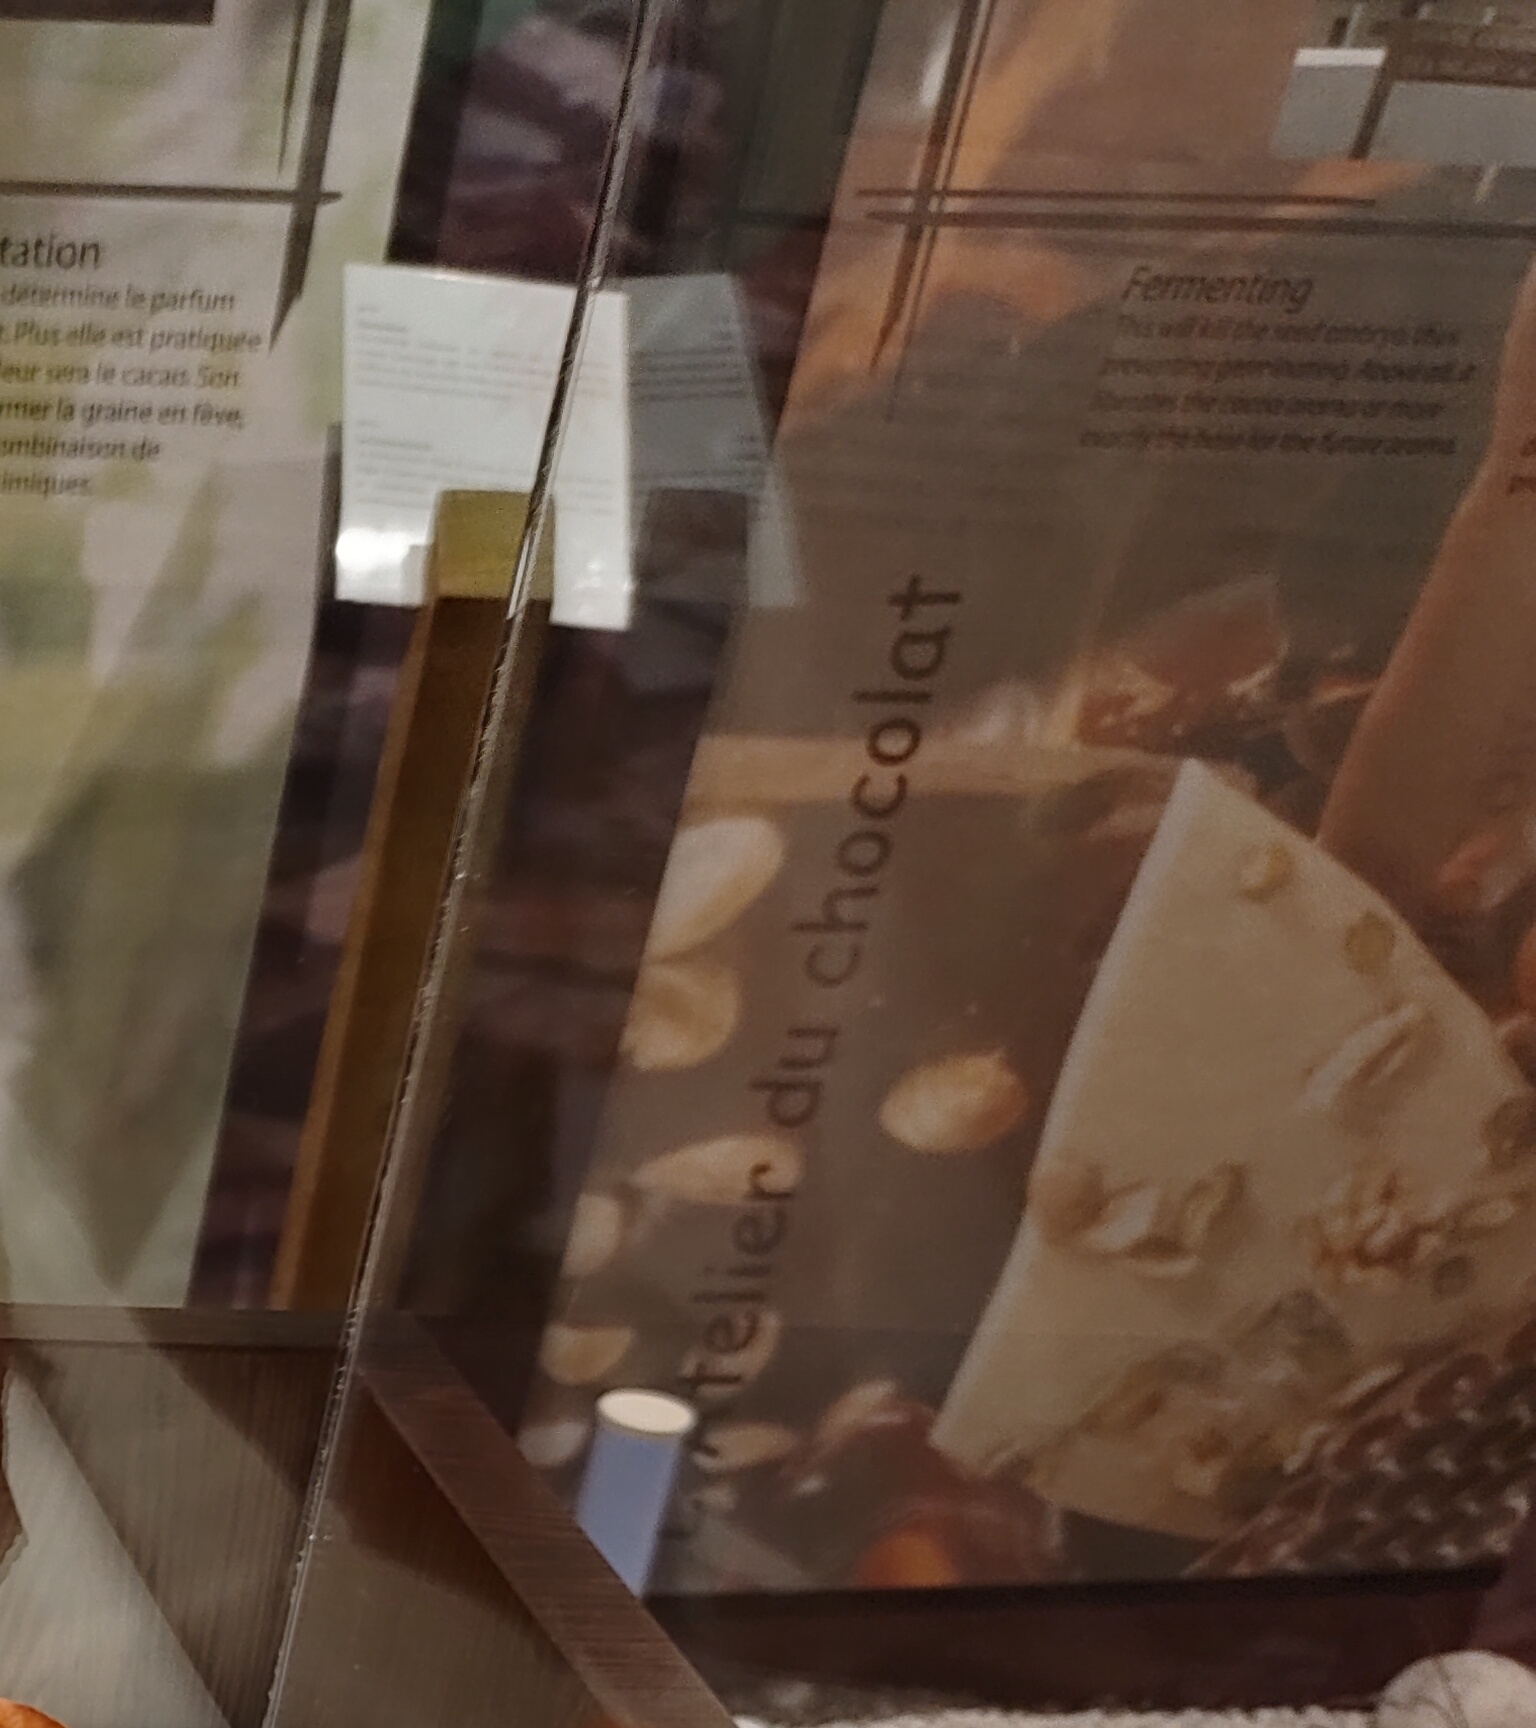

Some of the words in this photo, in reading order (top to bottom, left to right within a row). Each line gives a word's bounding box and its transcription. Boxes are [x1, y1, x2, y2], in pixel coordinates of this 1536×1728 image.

[125, 283, 146, 309] le
[149, 287, 236, 316] parfum
[1121, 265, 1314, 314] Fermenting
[14, 320, 60, 347] Plus
[65, 323, 106, 348] elle
[111, 325, 145, 349] est
[95, 360, 117, 386] le
[197, 363, 240, 389] Son
[56, 396, 76, 422] la
[82, 399, 152, 429] graine
[157, 404, 187, 426] en
[131, 436, 161, 462] de
[790, 573, 962, 990] chocolat
[753, 1024, 836, 1129] du
